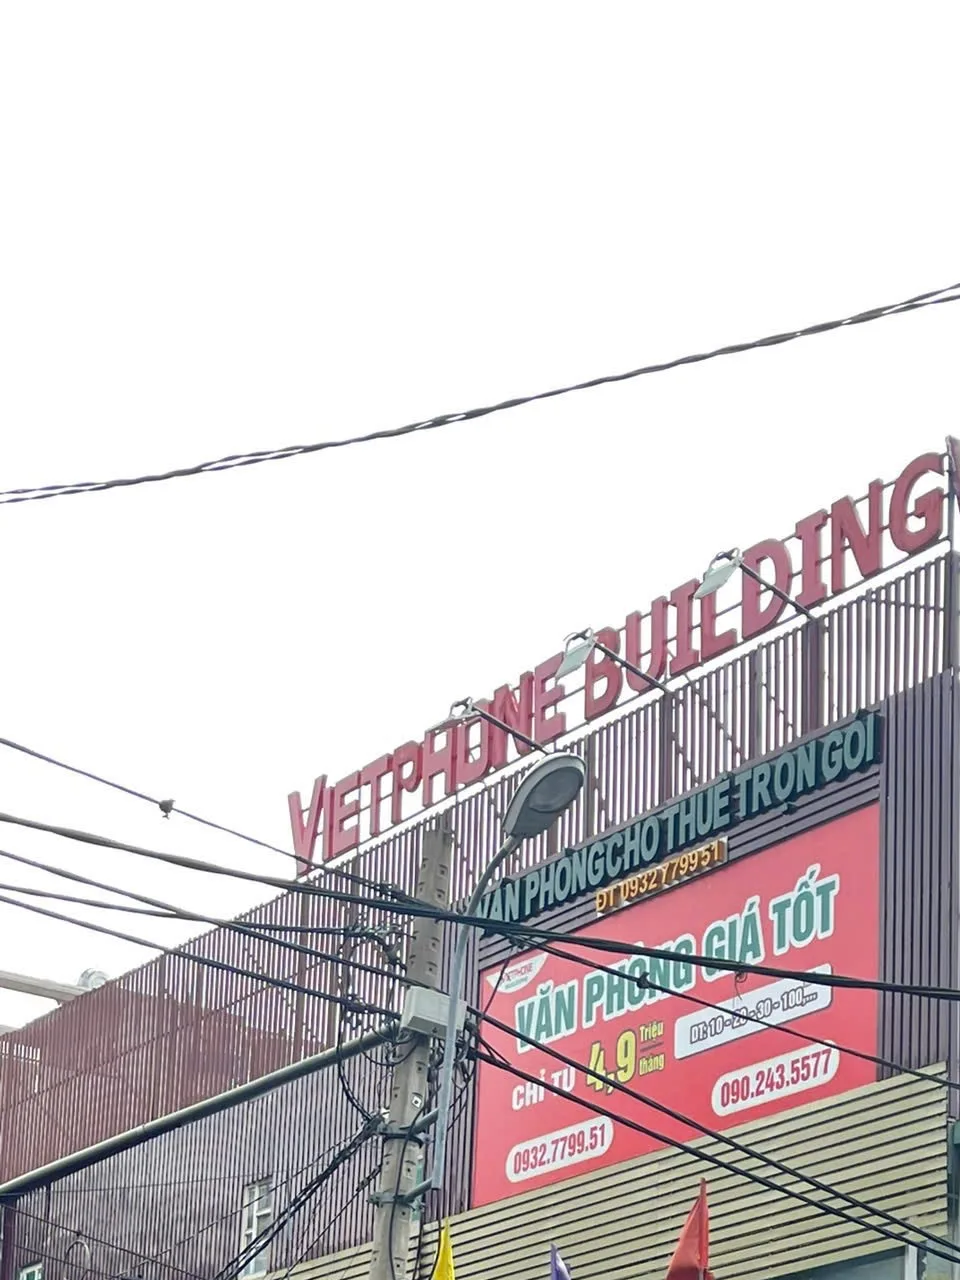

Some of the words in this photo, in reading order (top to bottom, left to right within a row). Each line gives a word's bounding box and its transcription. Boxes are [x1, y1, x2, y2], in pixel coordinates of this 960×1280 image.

[288, 653, 566, 875] VIETPHONE
[584, 452, 944, 722] BUILDING
[604, 815, 659, 879] CHO
[664, 776, 731, 850] THUÊ
[621, 871, 657, 901] 0932
[516, 981, 576, 1050] VĂN
[703, 900, 763, 977] GIÁ
[771, 868, 837, 950] TỐT
[640, 1020, 664, 1043] Triệu
[709, 1016, 723, 1037] 10
[756, 998, 772, 1021] 30
[586, 1031, 637, 1094] 4,9
[639, 1053, 665, 1076] tháng
[720, 1048, 832, 1108] 090.243.5577
[513, 1123, 605, 1174] 0932.7799.51
